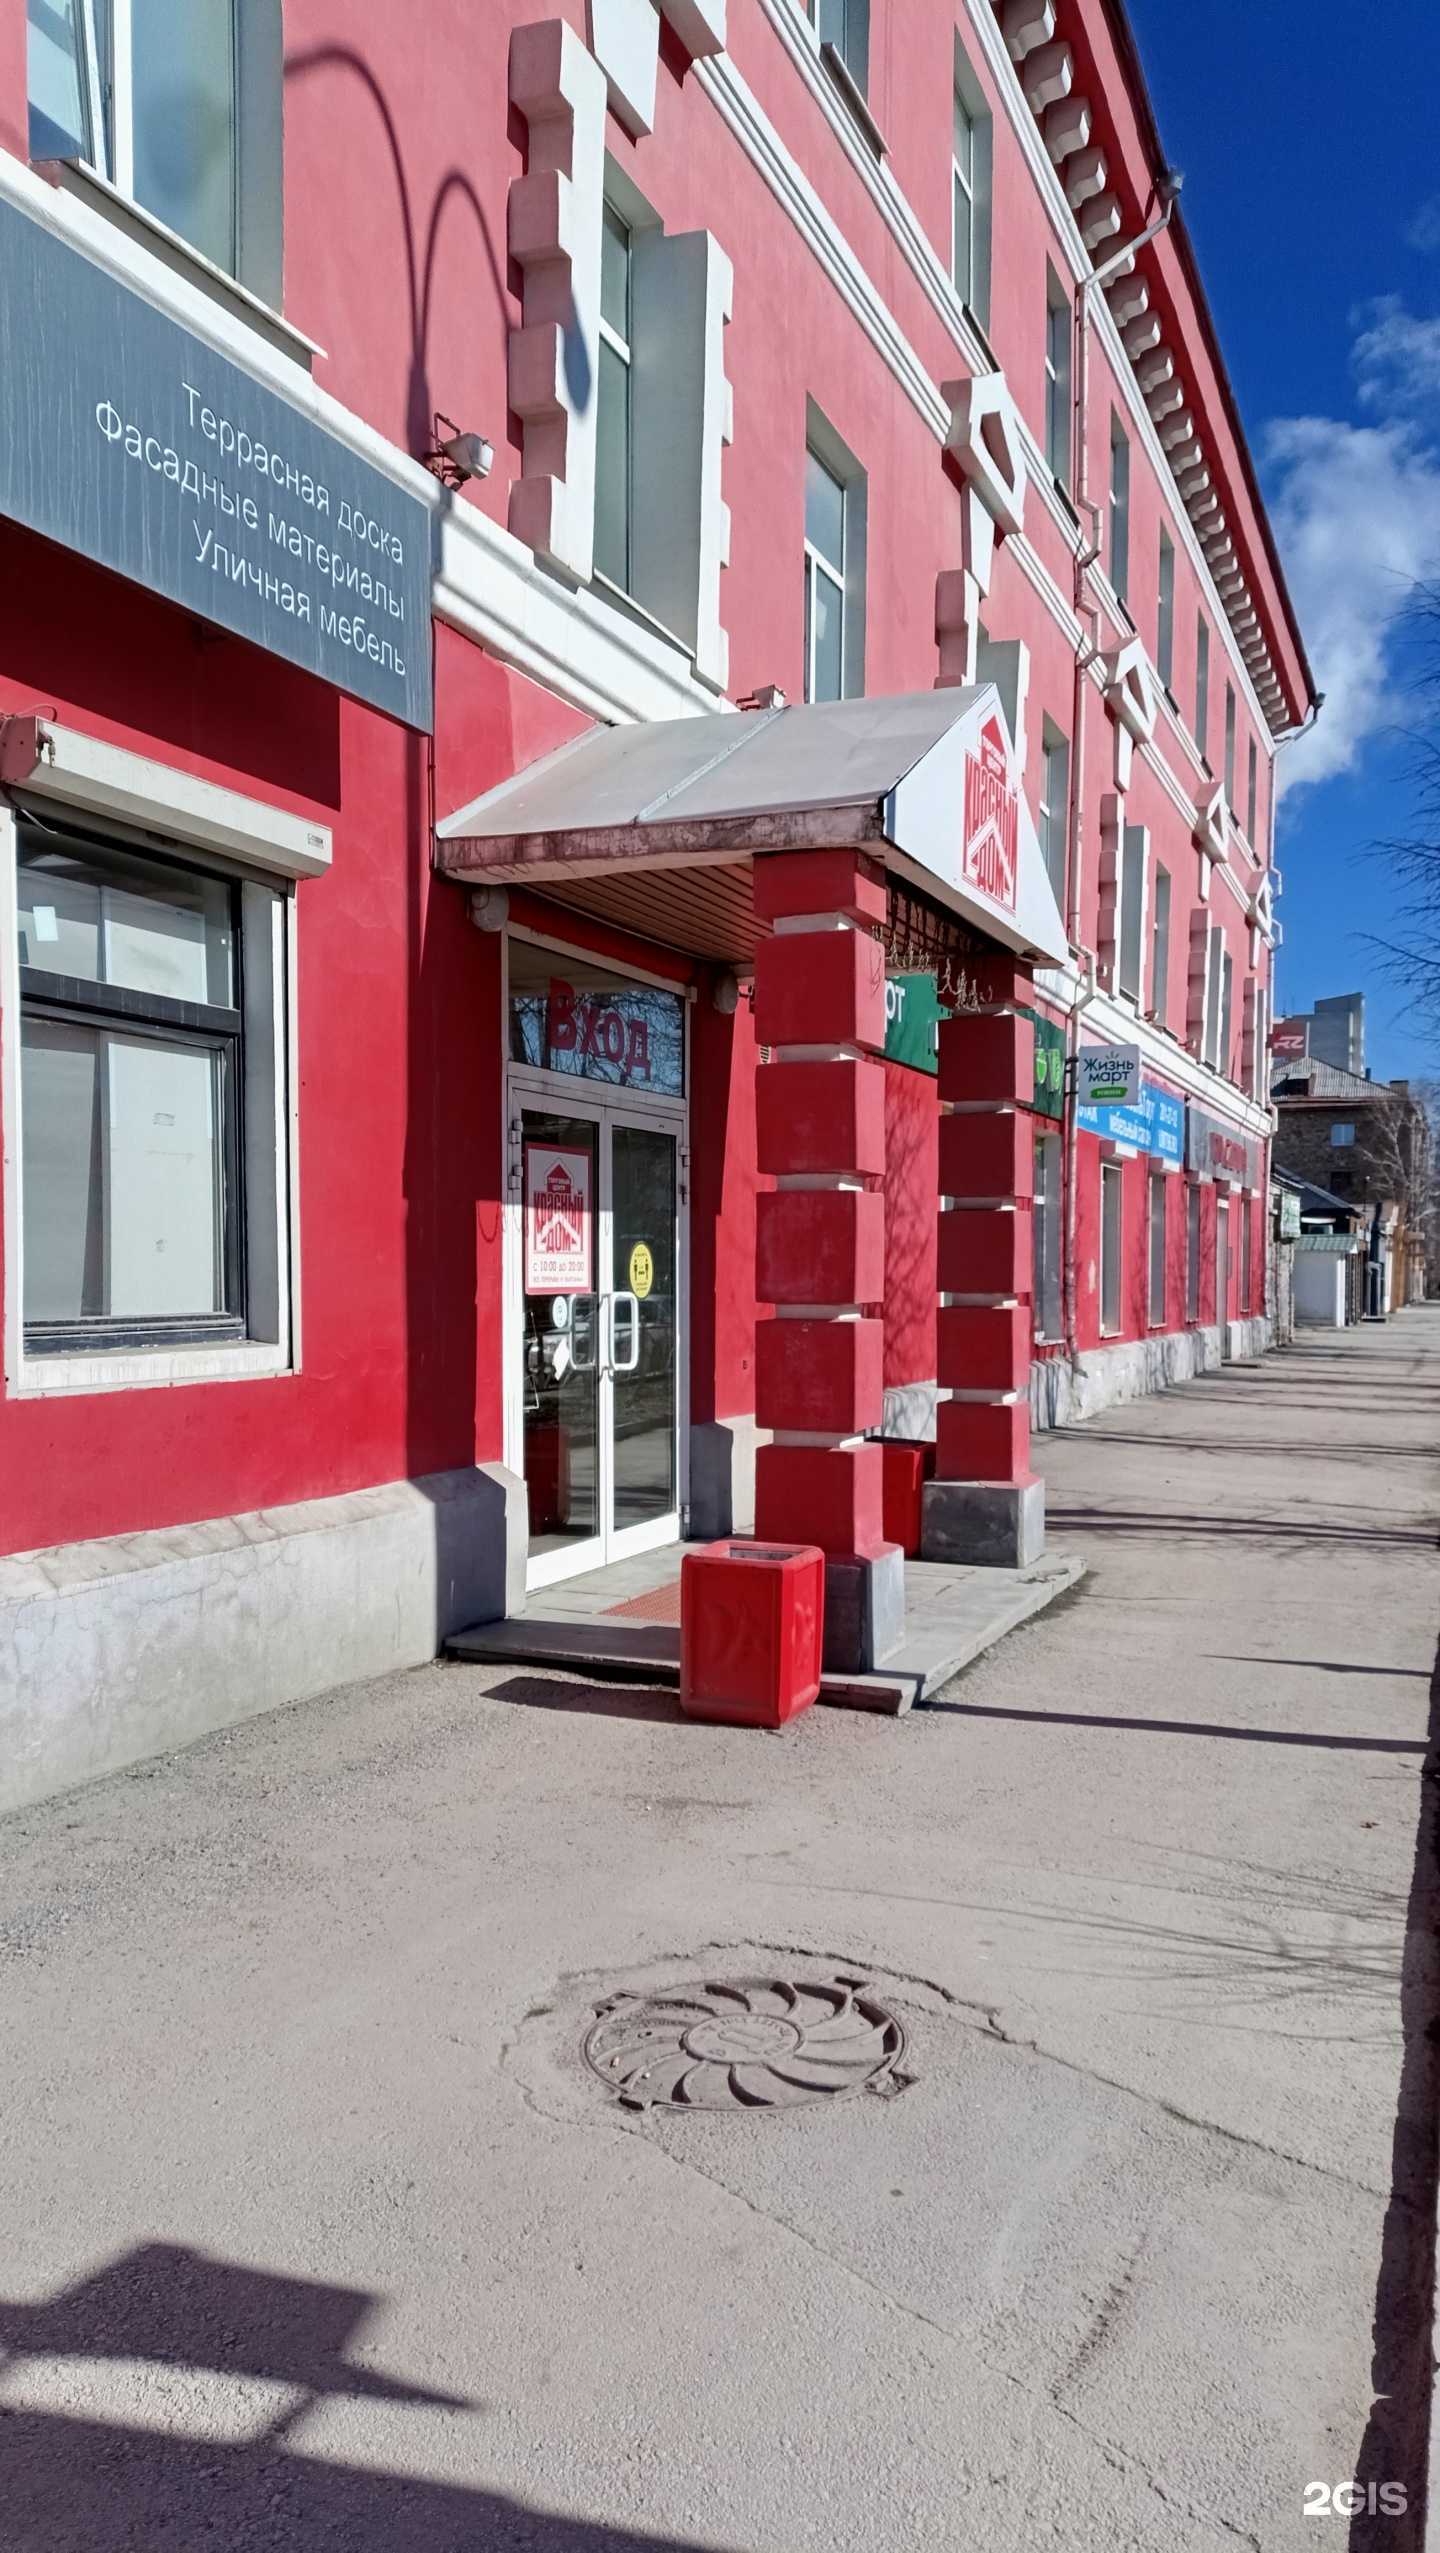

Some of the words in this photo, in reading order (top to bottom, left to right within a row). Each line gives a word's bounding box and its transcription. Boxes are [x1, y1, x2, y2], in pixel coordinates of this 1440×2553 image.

[95, 400, 258, 529] Фасадные
[269, 512, 404, 621] материалы
[182, 382, 330, 516] Террасная
[338, 501, 403, 565] доска
[193, 520, 310, 623] Уличная
[320, 604, 406, 675] мебель
[1083, 1057, 1134, 1072] Жизнь
[1088, 1071, 1131, 1085] март
